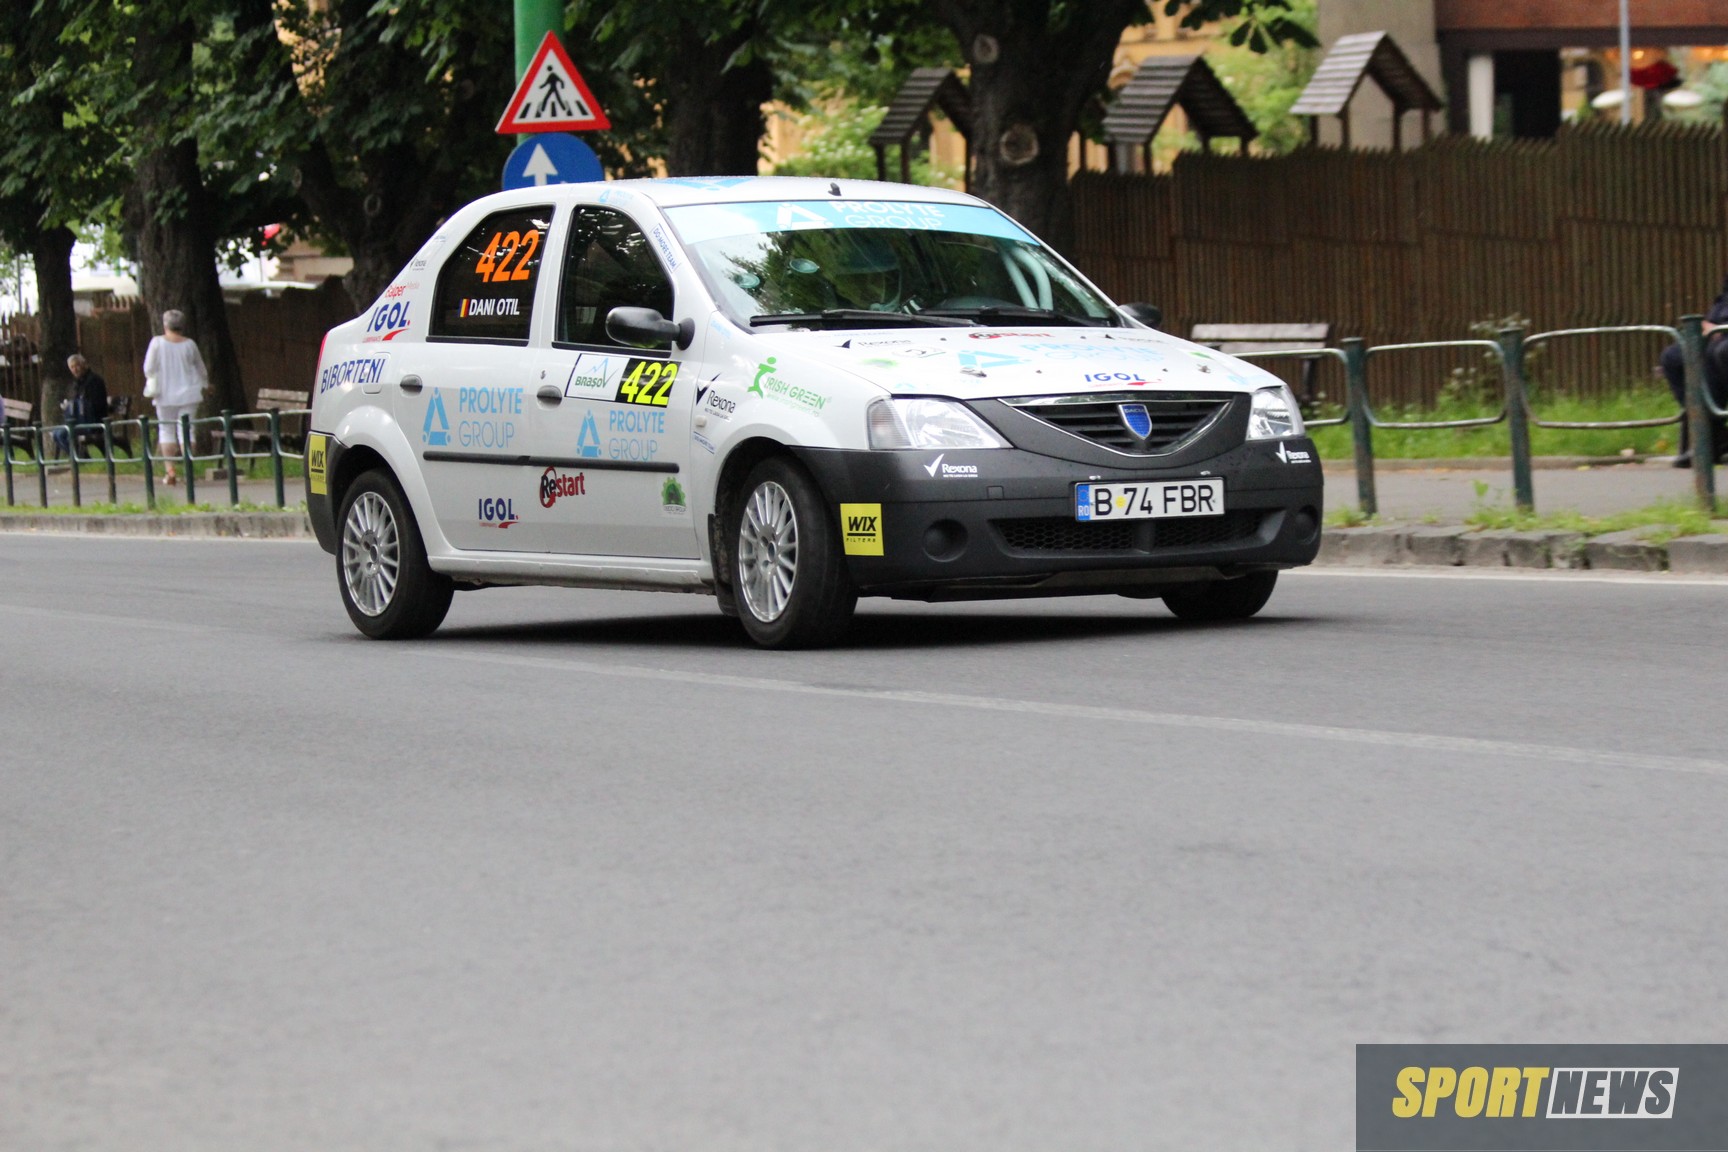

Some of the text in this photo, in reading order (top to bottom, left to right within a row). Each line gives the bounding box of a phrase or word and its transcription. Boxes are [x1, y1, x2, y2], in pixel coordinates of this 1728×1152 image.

[826, 201, 945, 217] PROLYTE
[845, 214, 943, 230] GROUP
[475, 229, 540, 283] 422
[469, 299, 520, 316] DANI OTIL
[320, 359, 386, 394] BIBORTENI
[620, 361, 678, 406] 422
[459, 387, 524, 414] PROLYTE
[707, 390, 736, 414] Rexona
[764, 377, 827, 410] IRISH GREEN
[459, 420, 515, 448] GROUP
[609, 410, 665, 434] PROLYTE
[311, 450, 324, 468] WIX
[608, 438, 658, 461] GROUP
[941, 463, 978, 474] Rexona
[540, 471, 586, 500] Restart
[1078, 484, 1215, 517] RO B 74 FBR
[848, 516, 878, 532] WIX
